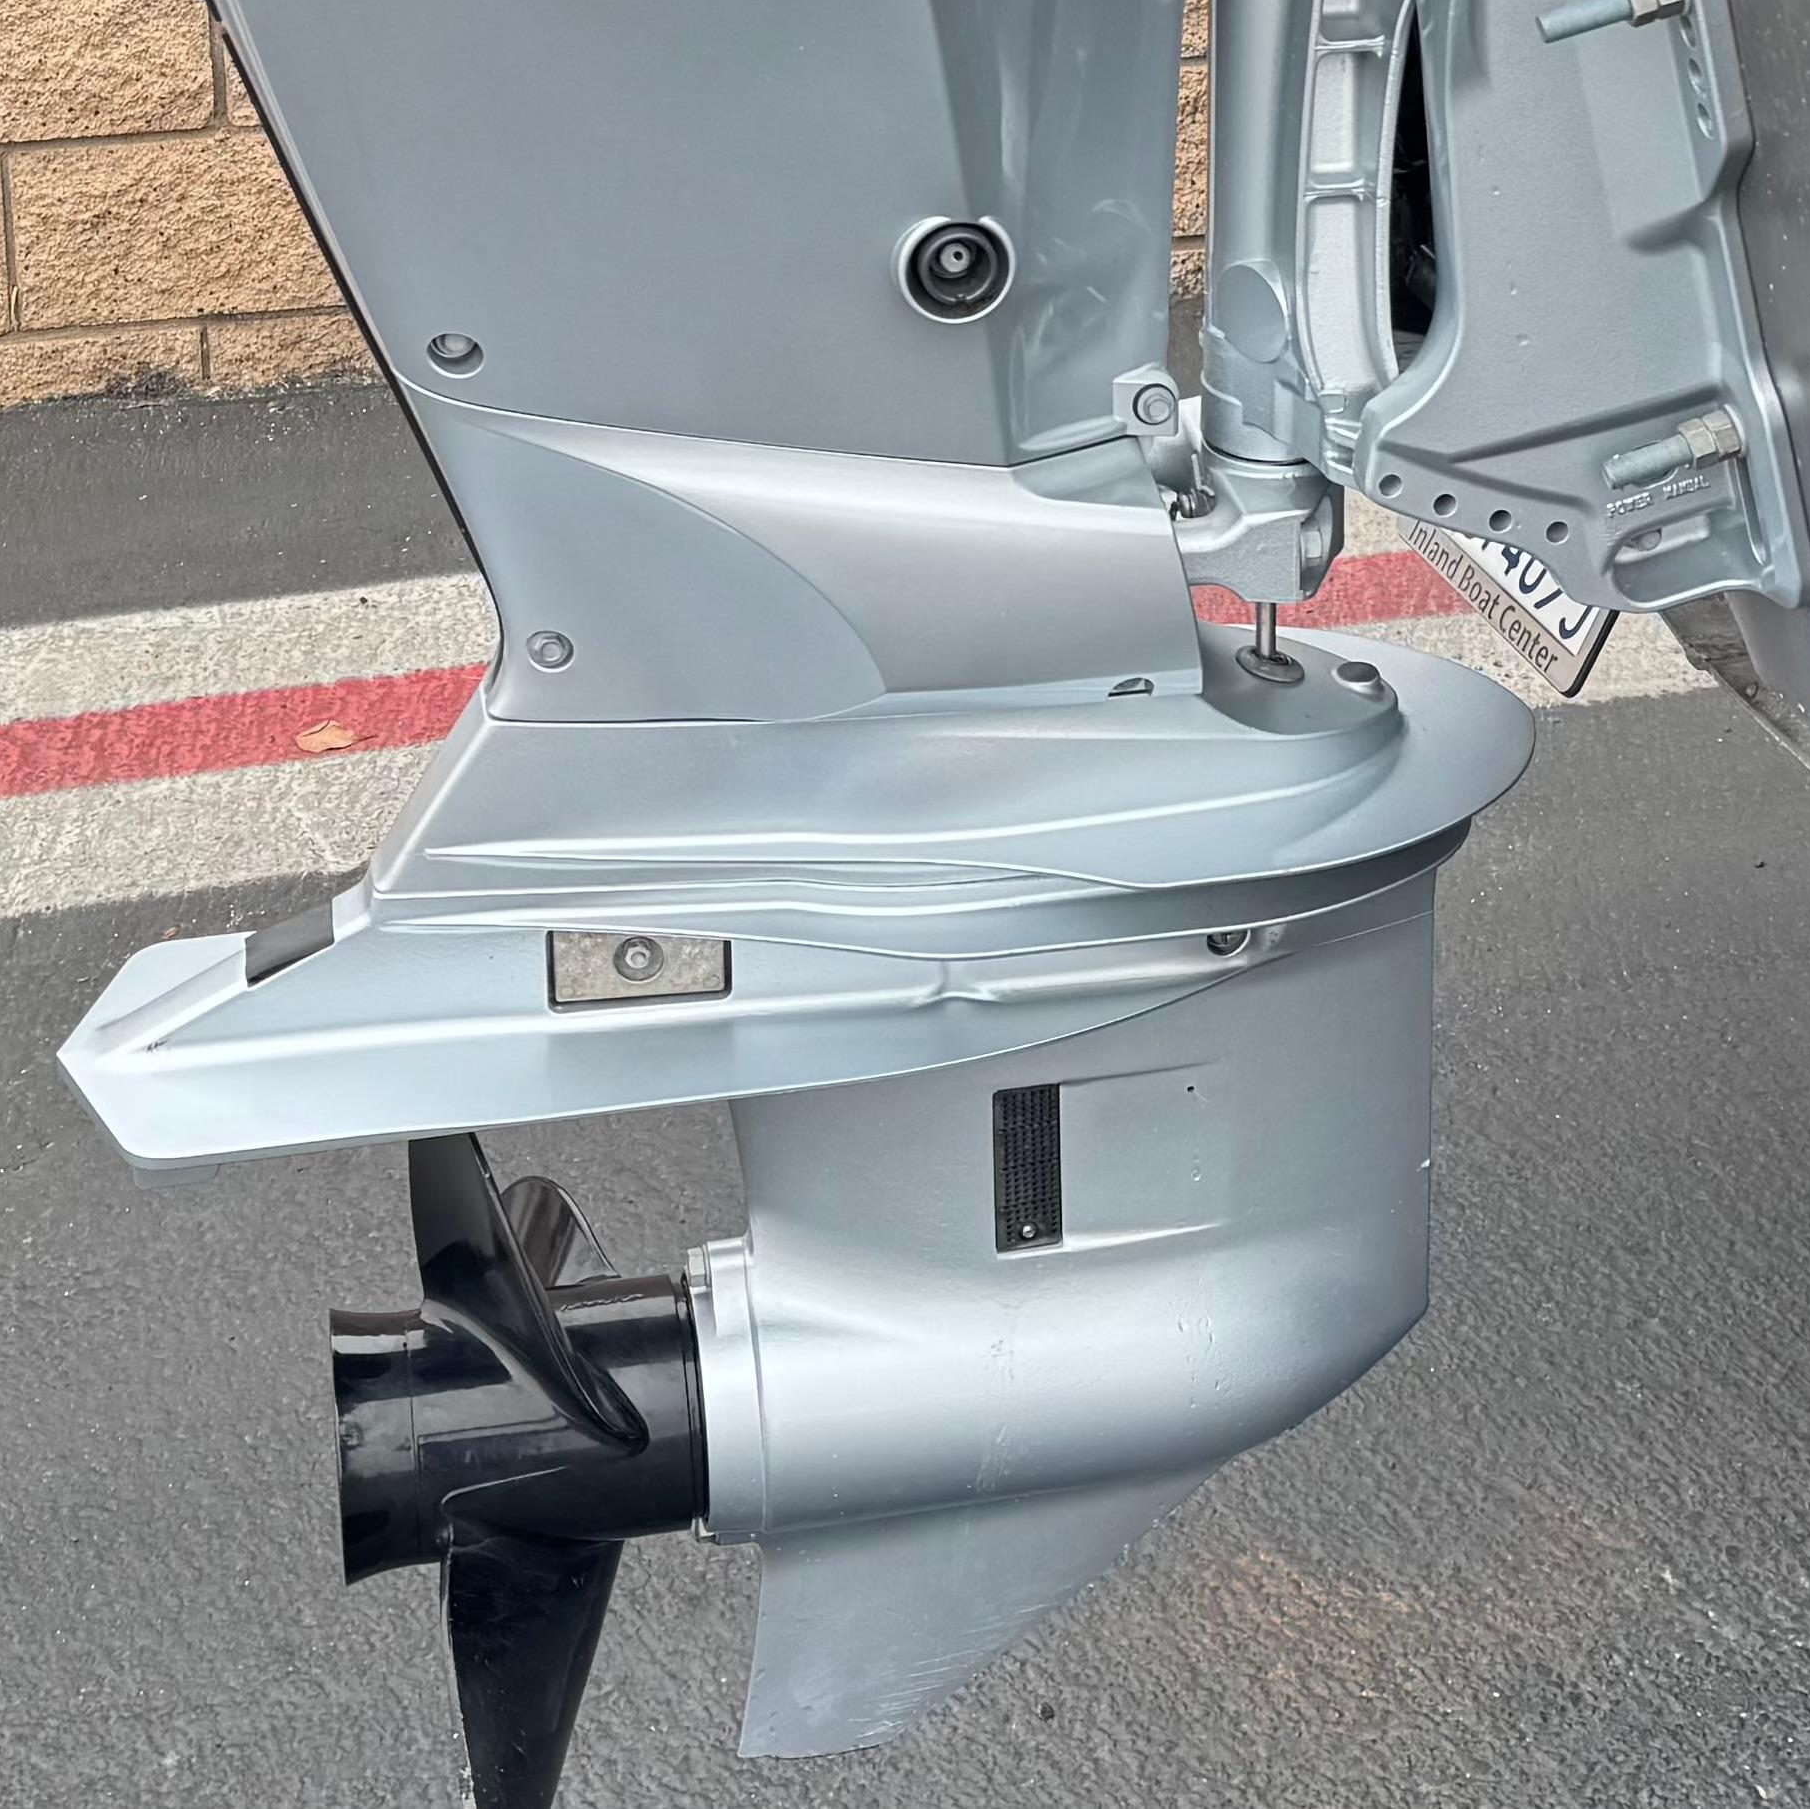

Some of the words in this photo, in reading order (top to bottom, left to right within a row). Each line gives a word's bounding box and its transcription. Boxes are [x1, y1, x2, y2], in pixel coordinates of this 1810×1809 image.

[1408, 520, 1463, 579] Inland
[1458, 563, 1500, 620] Boat
[1498, 605, 1558, 673] Center
